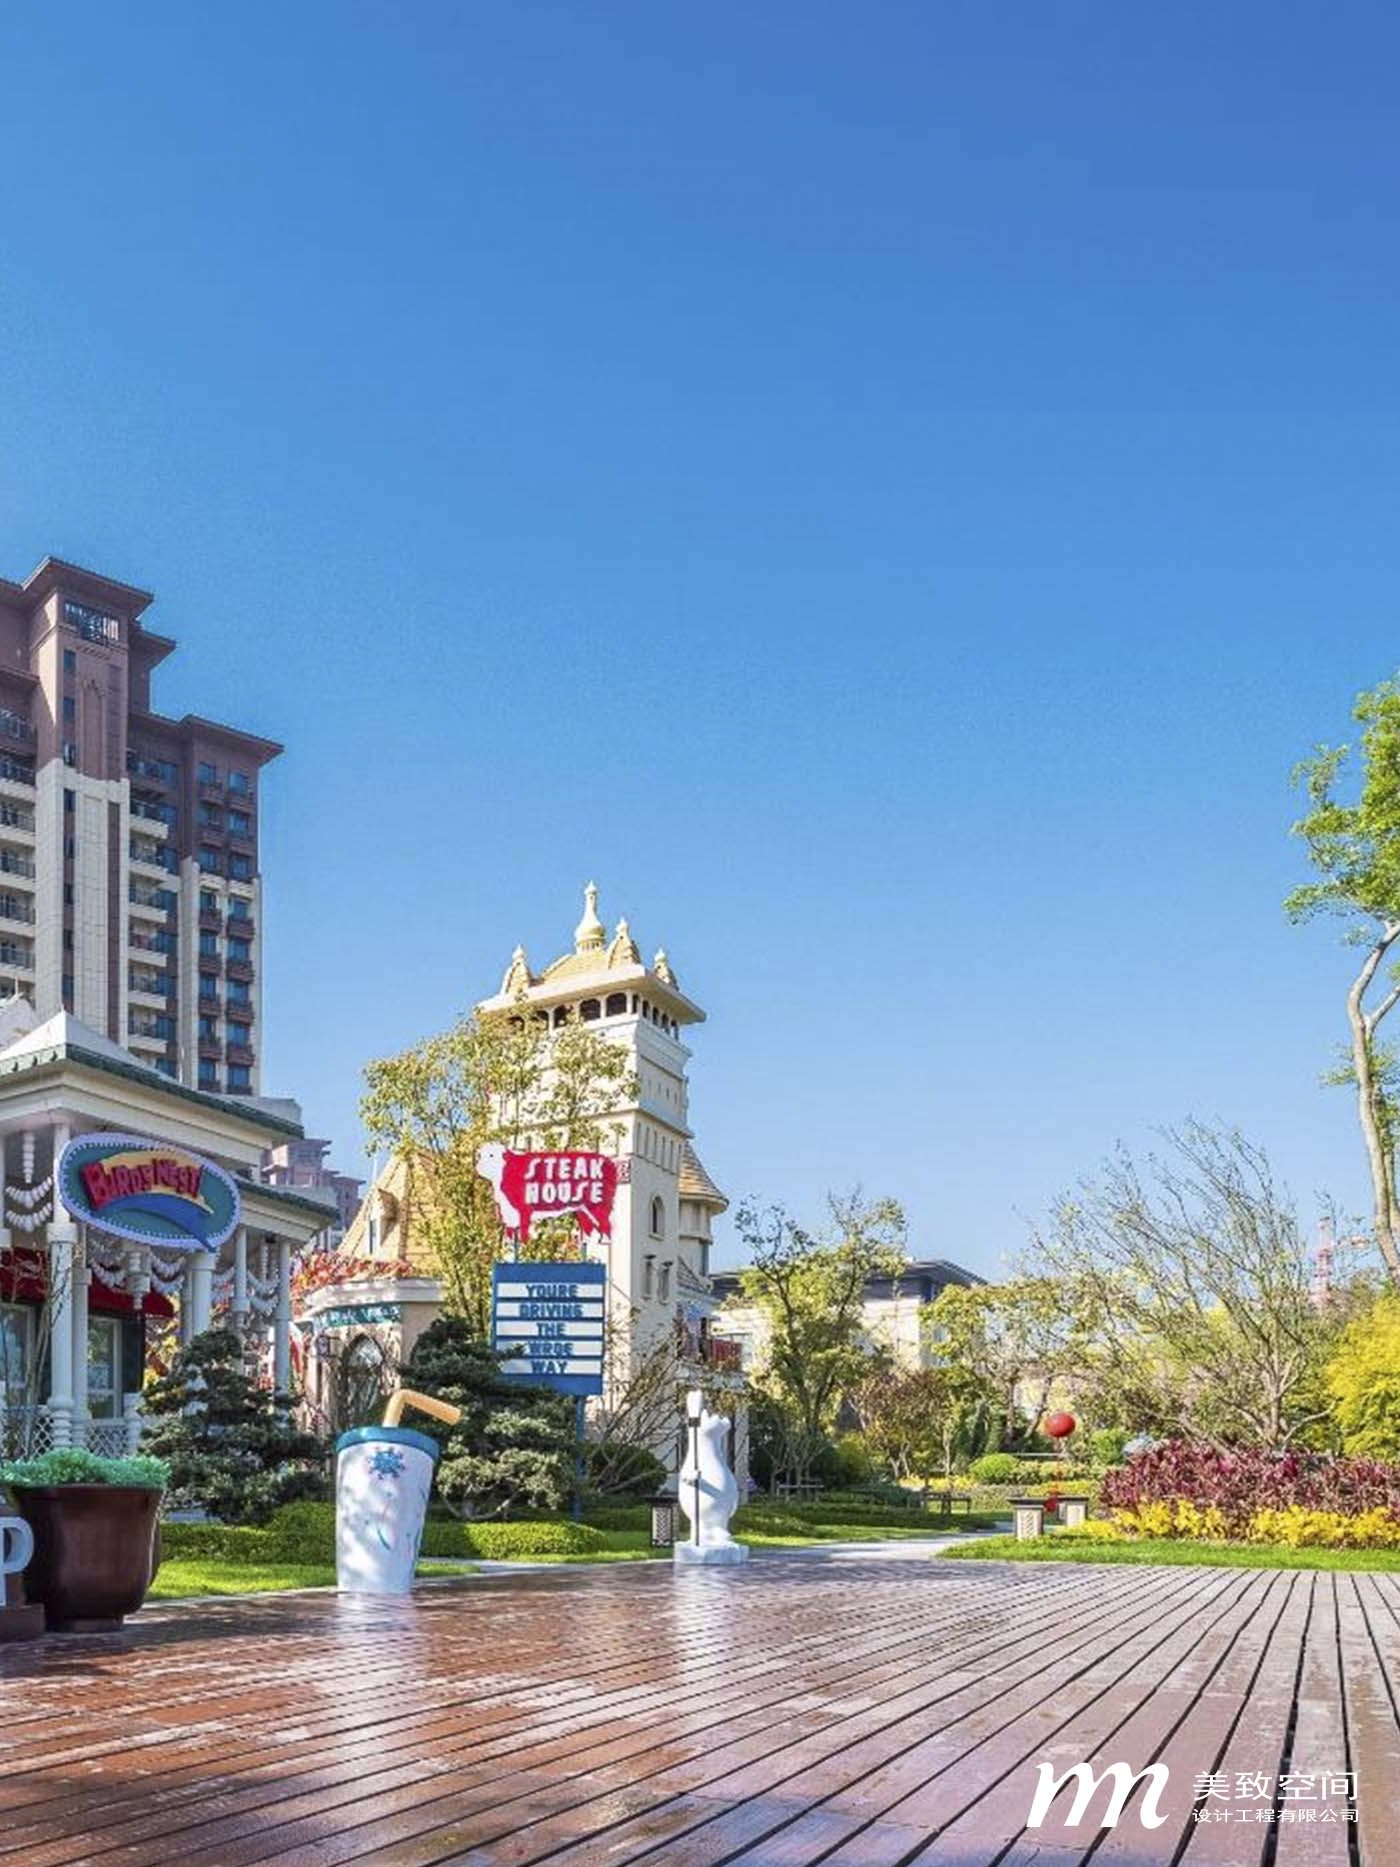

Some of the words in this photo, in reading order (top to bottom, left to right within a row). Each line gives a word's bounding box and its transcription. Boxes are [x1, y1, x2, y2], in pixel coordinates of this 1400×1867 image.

[524, 1157, 604, 1180] STEAK
[525, 1181, 604, 1204] HOUSE
[519, 1303, 584, 1317] DRIVING
[536, 1322, 567, 1336] THE
[531, 1360, 568, 1375] WAY
